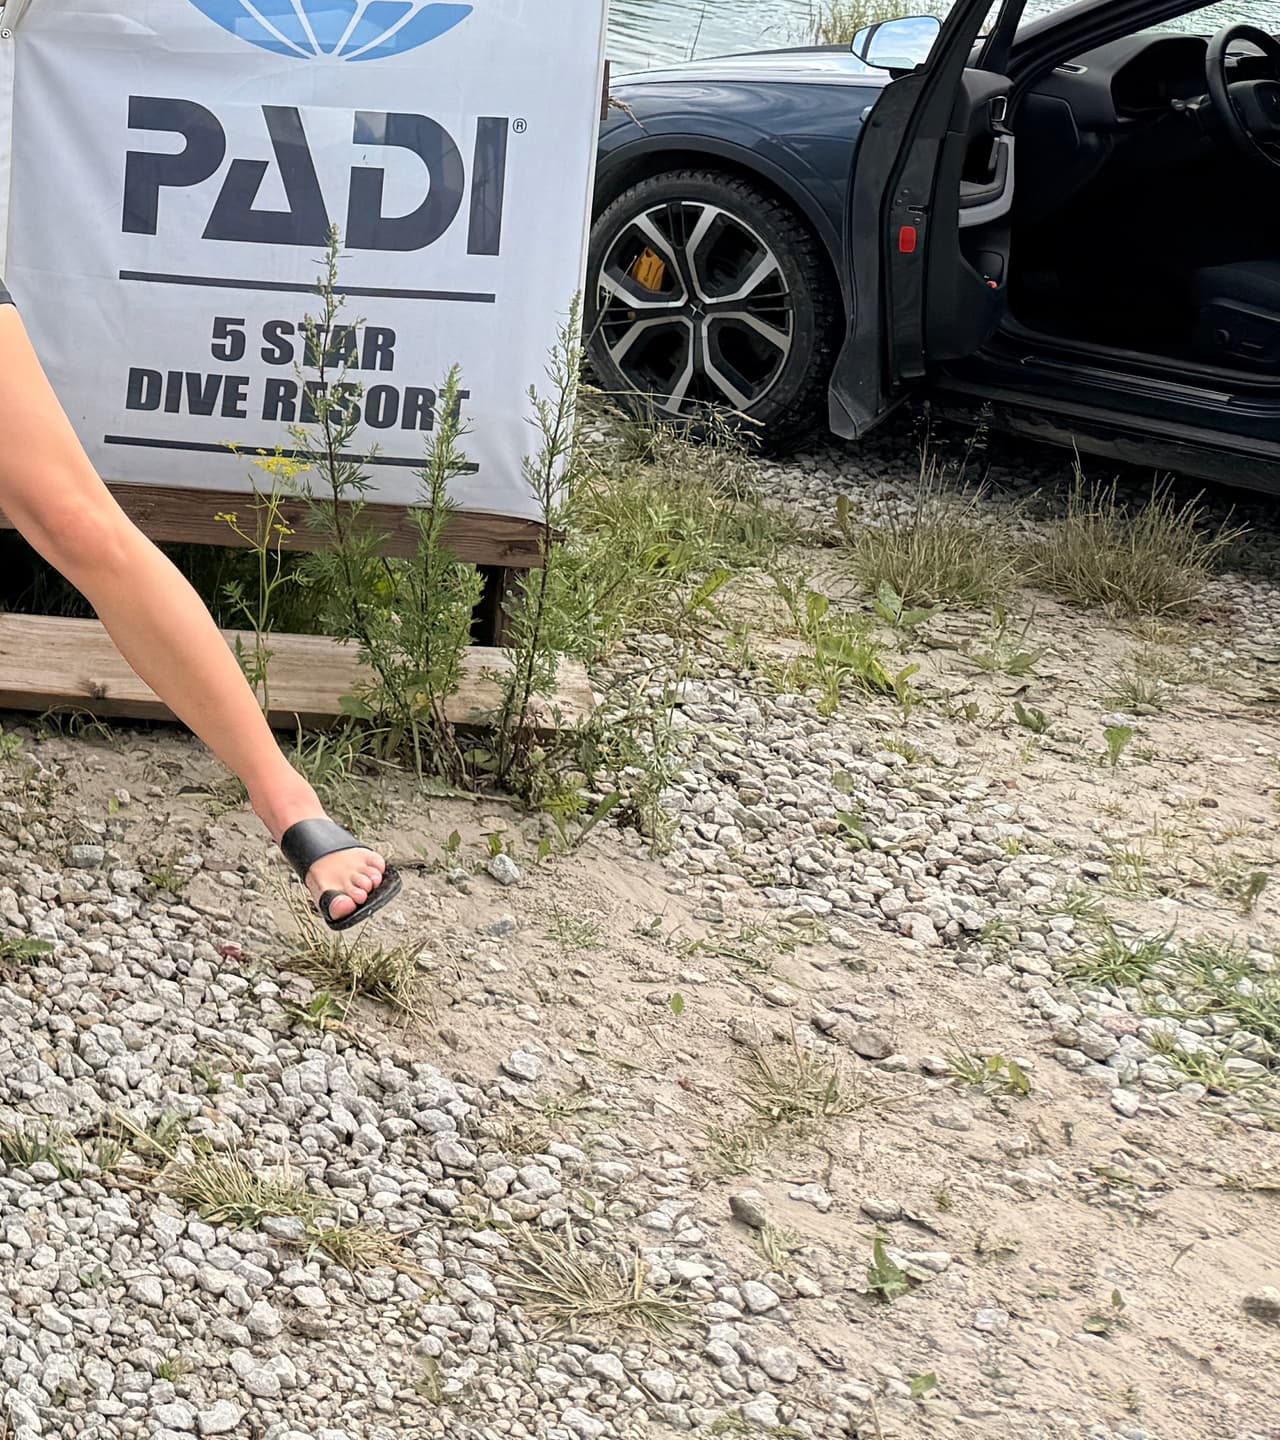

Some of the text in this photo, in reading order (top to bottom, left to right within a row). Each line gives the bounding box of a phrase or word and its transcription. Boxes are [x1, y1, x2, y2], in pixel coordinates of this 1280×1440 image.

[122, 95, 509, 256] PADI
[210, 316, 397, 372] 5 STAR
[125, 367, 250, 419] DIVE
